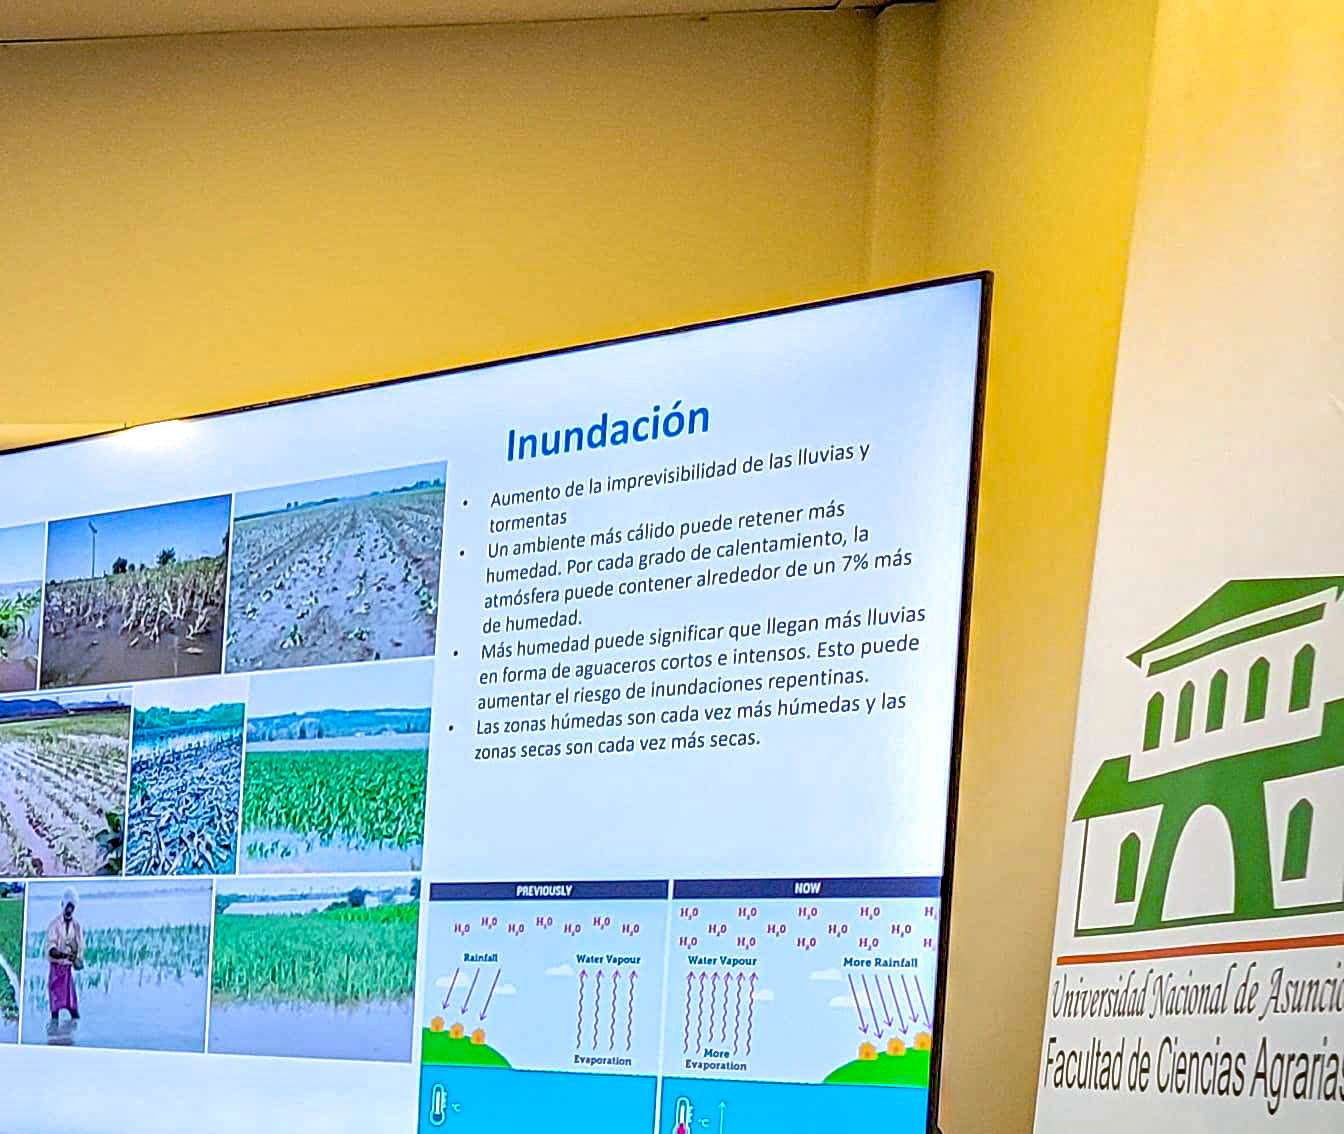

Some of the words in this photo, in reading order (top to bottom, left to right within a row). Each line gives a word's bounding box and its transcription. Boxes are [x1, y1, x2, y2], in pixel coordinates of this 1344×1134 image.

[507, 399, 709, 463] Inundación
[490, 485, 561, 509] Aumento
[564, 479, 585, 498] de
[589, 477, 602, 495] la
[607, 457, 737, 493] imprevisibilidad
[742, 455, 764, 474] de
[769, 452, 793, 471] las
[797, 444, 855, 467] lluvias
[859, 443, 871, 462] y
[488, 541, 509, 559] Un
[512, 533, 586, 556] ambiente
[590, 526, 623, 547] más
[626, 520, 675, 542] cálido
[679, 513, 733, 541] puede
[738, 508, 805, 529] retener
[808, 499, 845, 521] más
[489, 511, 567, 534] tormentas
[486, 559, 562, 585] humedad.
[567, 559, 593, 575] Por
[597, 551, 634, 572] cada
[637, 545, 686, 571] grado
[690, 543, 712, 561] de
[716, 529, 847, 559] calentamiento,
[853, 524, 869, 543] la
[484, 586, 560, 609] atmósfera
[564, 579, 614, 605] puede
[618, 575, 693, 595] contener
[696, 562, 782, 588] alrededor
[785, 559, 808, 578] de
[813, 560, 836, 576] un
[841, 552, 869, 573] 7%
[874, 547, 913, 569] más
[481, 641, 513, 661] Más
[516, 633, 590, 657] humedad
[594, 629, 645, 654] puede
[648, 623, 725, 648] significar
[728, 623, 762, 643] que
[766, 616, 819, 637] llegan
[824, 609, 862, 631] más
[867, 605, 926, 627] lluvias
[482, 616, 501, 635] de
[505, 607, 583, 633] humedad.
[479, 671, 498, 685] en
[502, 665, 547, 684] forma
[551, 661, 571, 680] de
[575, 658, 657, 681] aguaceros
[660, 652, 713, 671] cortos
[717, 653, 728, 667] e
[733, 646, 811, 665] intensos.
[817, 640, 855, 659] Esto
[860, 633, 920, 659] puede
[477, 691, 553, 711] aumentar
[555, 687, 570, 705] el
[573, 685, 621, 705] riesgo
[625, 681, 646, 700] de
[650, 675, 763, 698] inundaciones
[768, 667, 869, 693] repentinas.
[476, 719, 500, 735] Las
[503, 718, 547, 734] zonas
[550, 709, 623, 731] húmedas
[626, 711, 656, 726] son
[660, 704, 699, 724] cada
[704, 706, 732, 721] vez
[737, 699, 773, 720] más
[777, 695, 861, 717] húmedas
[865, 697, 877, 715] y
[881, 691, 907, 711] las
[474, 745, 517, 761] zonas
[519, 743, 562, 758] secas
[565, 741, 593, 756] son
[597, 735, 635, 754] cada
[639, 737, 667, 751] vez
[671, 730, 705, 750] más
[709, 732, 761, 748] secas.
[516, 885, 572, 896] PREVIOUSLY
[794, 883, 821, 894] NOW
[463, 953, 498, 962] Rainfall
[576, 954, 604, 964] Water
[606, 954, 641, 966] Vapour
[688, 956, 717, 966] Water
[719, 956, 757, 968] Vapour
[843, 957, 871, 968] More
[875, 957, 918, 968] Rainfall
[1052, 968, 1154, 1018] Universidad
[1149, 962, 1238, 1019] Nacional
[1234, 961, 1259, 1014] de
[574, 1055, 632, 1067] Evaporation
[685, 1060, 747, 1071] Evaporation
[704, 1048, 730, 1059] More
[1044, 1037, 1126, 1090] Facultad
[1128, 1037, 1151, 1092] de
[1157, 1035, 1246, 1096] Ciencias
